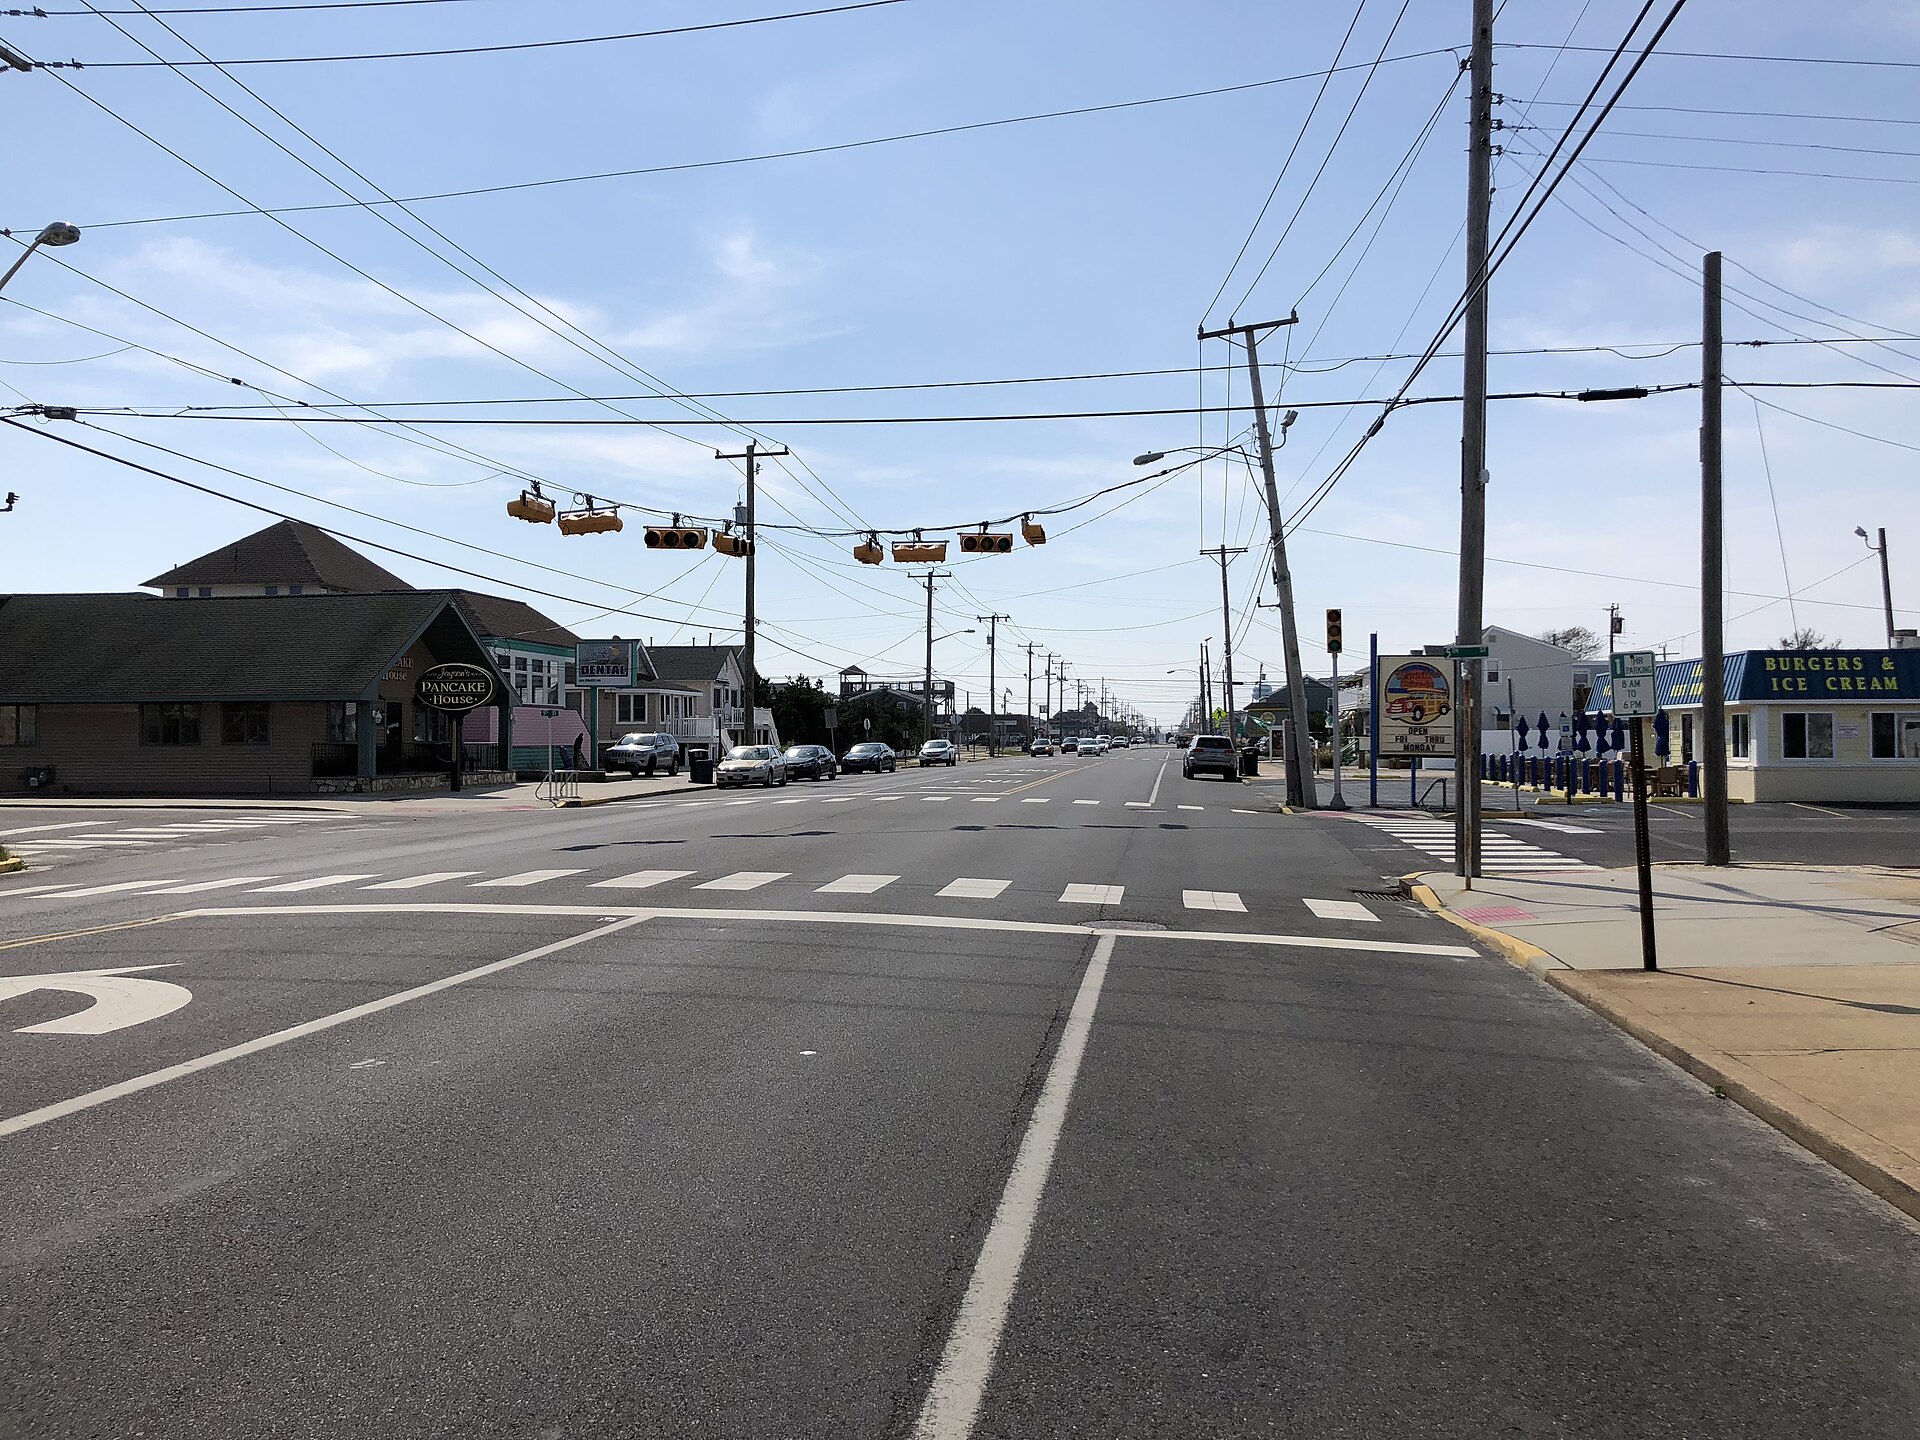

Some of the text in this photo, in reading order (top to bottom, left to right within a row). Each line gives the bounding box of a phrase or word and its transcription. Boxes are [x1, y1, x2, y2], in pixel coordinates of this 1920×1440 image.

[1614, 658, 1620, 674] 1
[1765, 656, 1895, 671] BURGERS &
[581, 665, 626, 675] DENTAL
[1626, 665, 1652, 674] PARKING
[422, 681, 486, 692] PANCAKE
[1771, 676, 1898, 691] ICE CREAM
[433, 694, 473, 705] House
